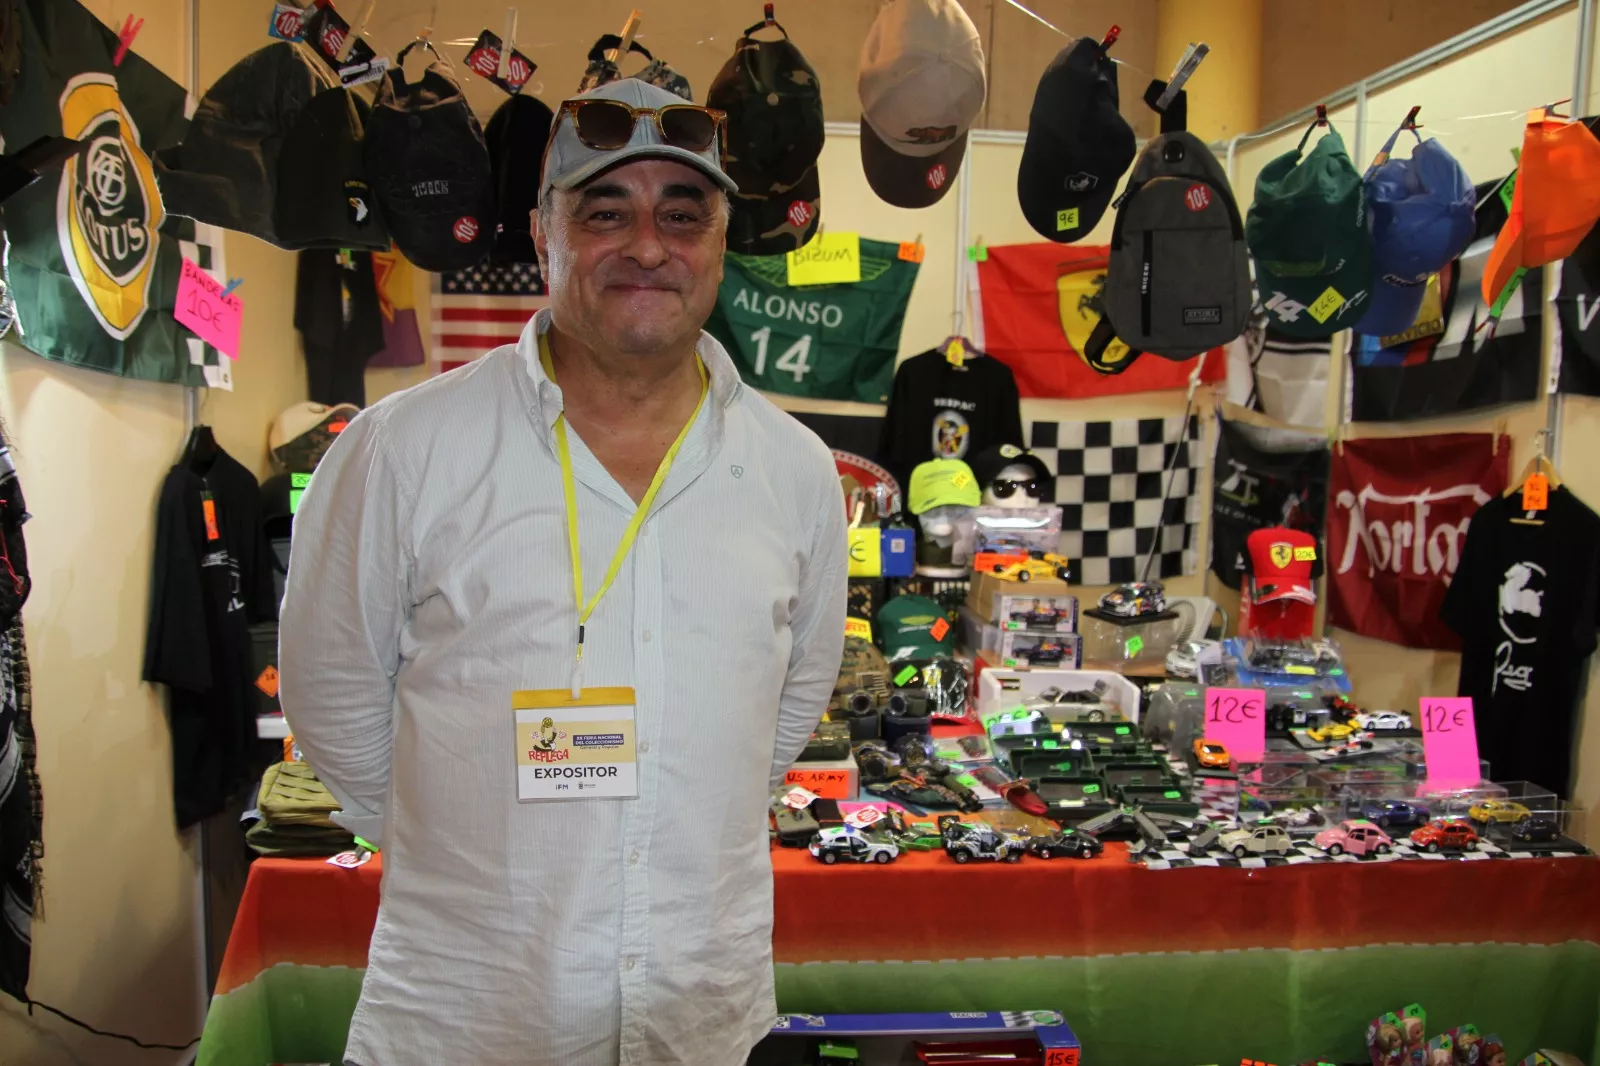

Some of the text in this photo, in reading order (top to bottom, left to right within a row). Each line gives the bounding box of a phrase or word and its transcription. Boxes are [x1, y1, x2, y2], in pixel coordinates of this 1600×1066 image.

[929, 164, 945, 189] 10€
[1187, 186, 1209, 210] 10€
[790, 201, 810, 226] 10€
[1059, 212, 1075, 225] 9€
[455, 217, 478, 241] 10€
[186, 288, 224, 334] 10€
[733, 288, 843, 328] ALONSO
[750, 325, 813, 383] 14
[1209, 696, 1261, 723] 12€
[1425, 705, 1467, 732] 12€
[528, 748, 569, 763] REPLEGA
[534, 766, 618, 779] EXPOSITOR
[787, 772, 845, 783] US ARMY
[1047, 1052, 1075, 1066] 15€
